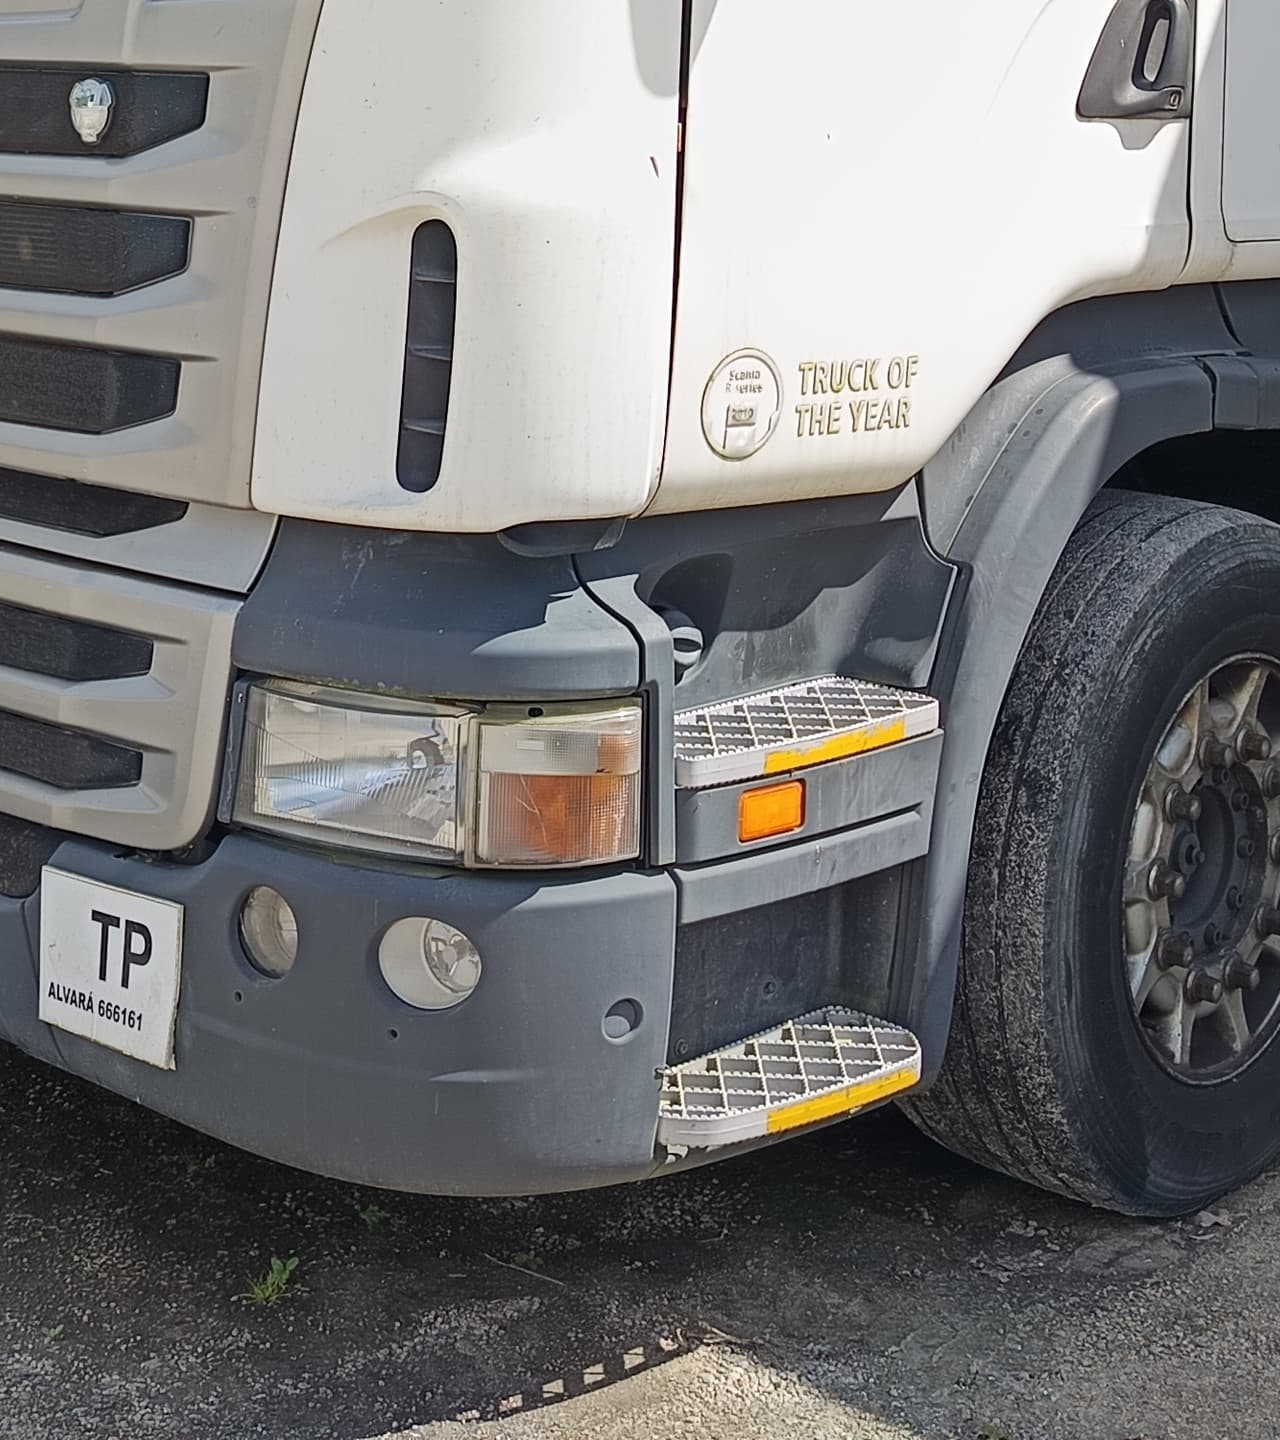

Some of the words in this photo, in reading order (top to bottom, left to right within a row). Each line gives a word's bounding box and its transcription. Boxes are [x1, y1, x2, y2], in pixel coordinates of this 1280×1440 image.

[799, 358, 881, 396] TRUCK
[887, 355, 918, 390] OF
[795, 401, 842, 437] THE
[849, 396, 911, 433] YEAR
[91, 909, 153, 989] TP
[98, 1000, 143, 1032] 666161
